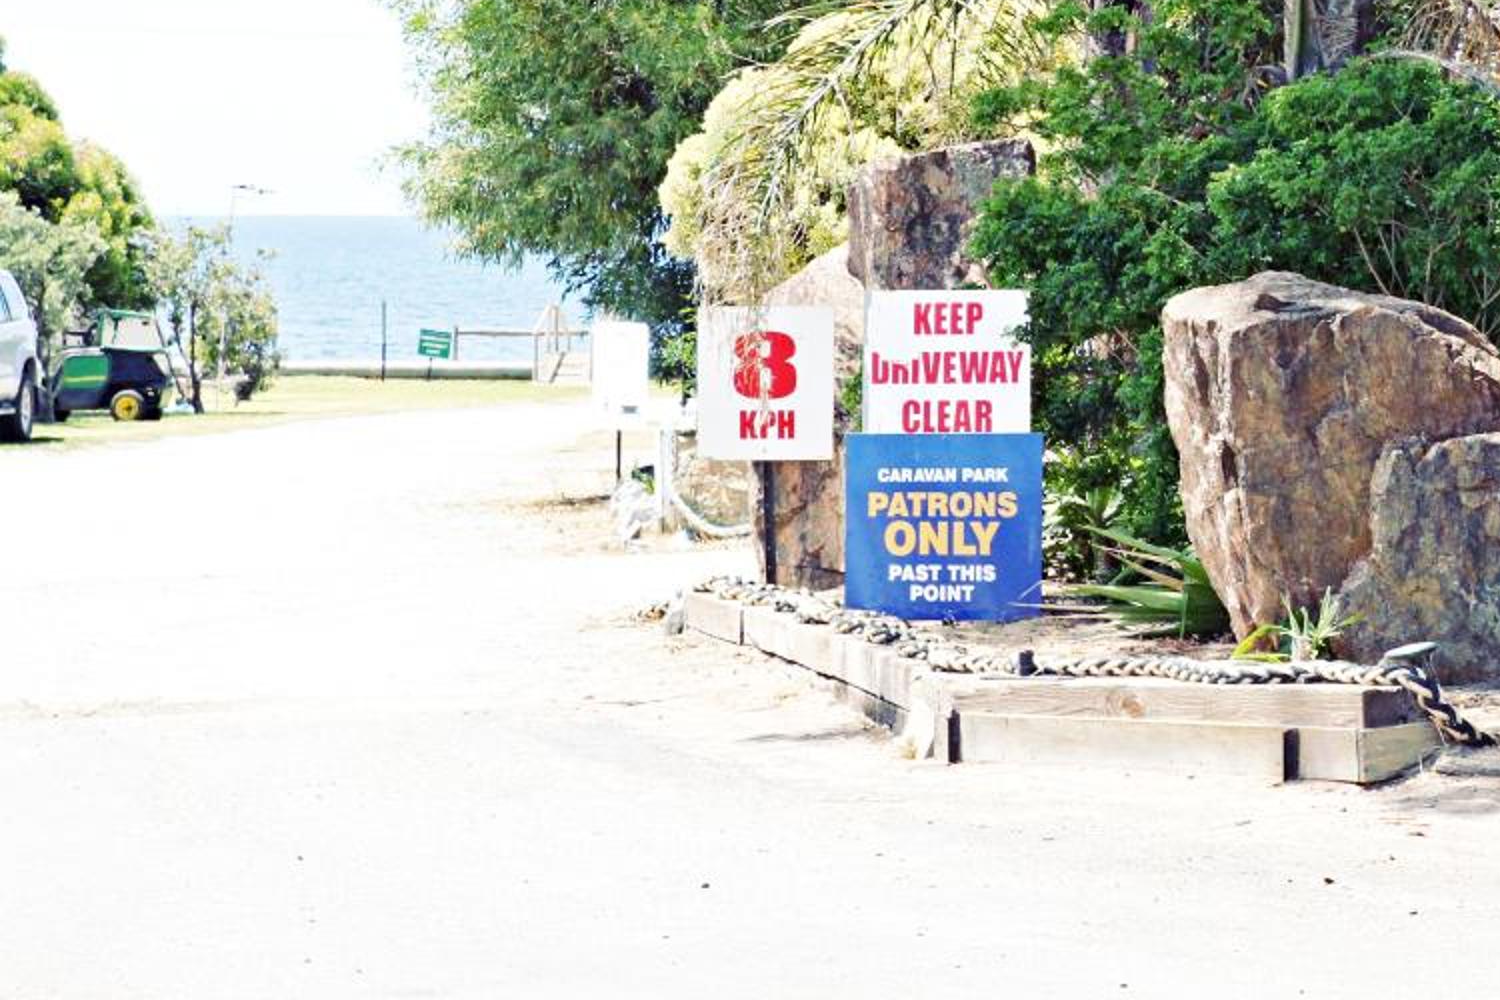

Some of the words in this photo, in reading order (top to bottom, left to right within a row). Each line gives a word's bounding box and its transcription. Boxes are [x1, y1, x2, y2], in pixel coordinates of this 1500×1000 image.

[913, 302, 984, 335] KEEP
[733, 331, 797, 400] 8
[739, 409, 795, 440] KPH
[901, 399, 993, 434] CLEAR
[877, 468, 957, 483] CARAVAN
[961, 467, 1009, 483] PARK
[867, 491, 1019, 518] PATRONS
[883, 520, 1000, 557] ONLY
[887, 564, 943, 582] PAST
[948, 564, 997, 582] THIS
[909, 584, 975, 602] POINT
